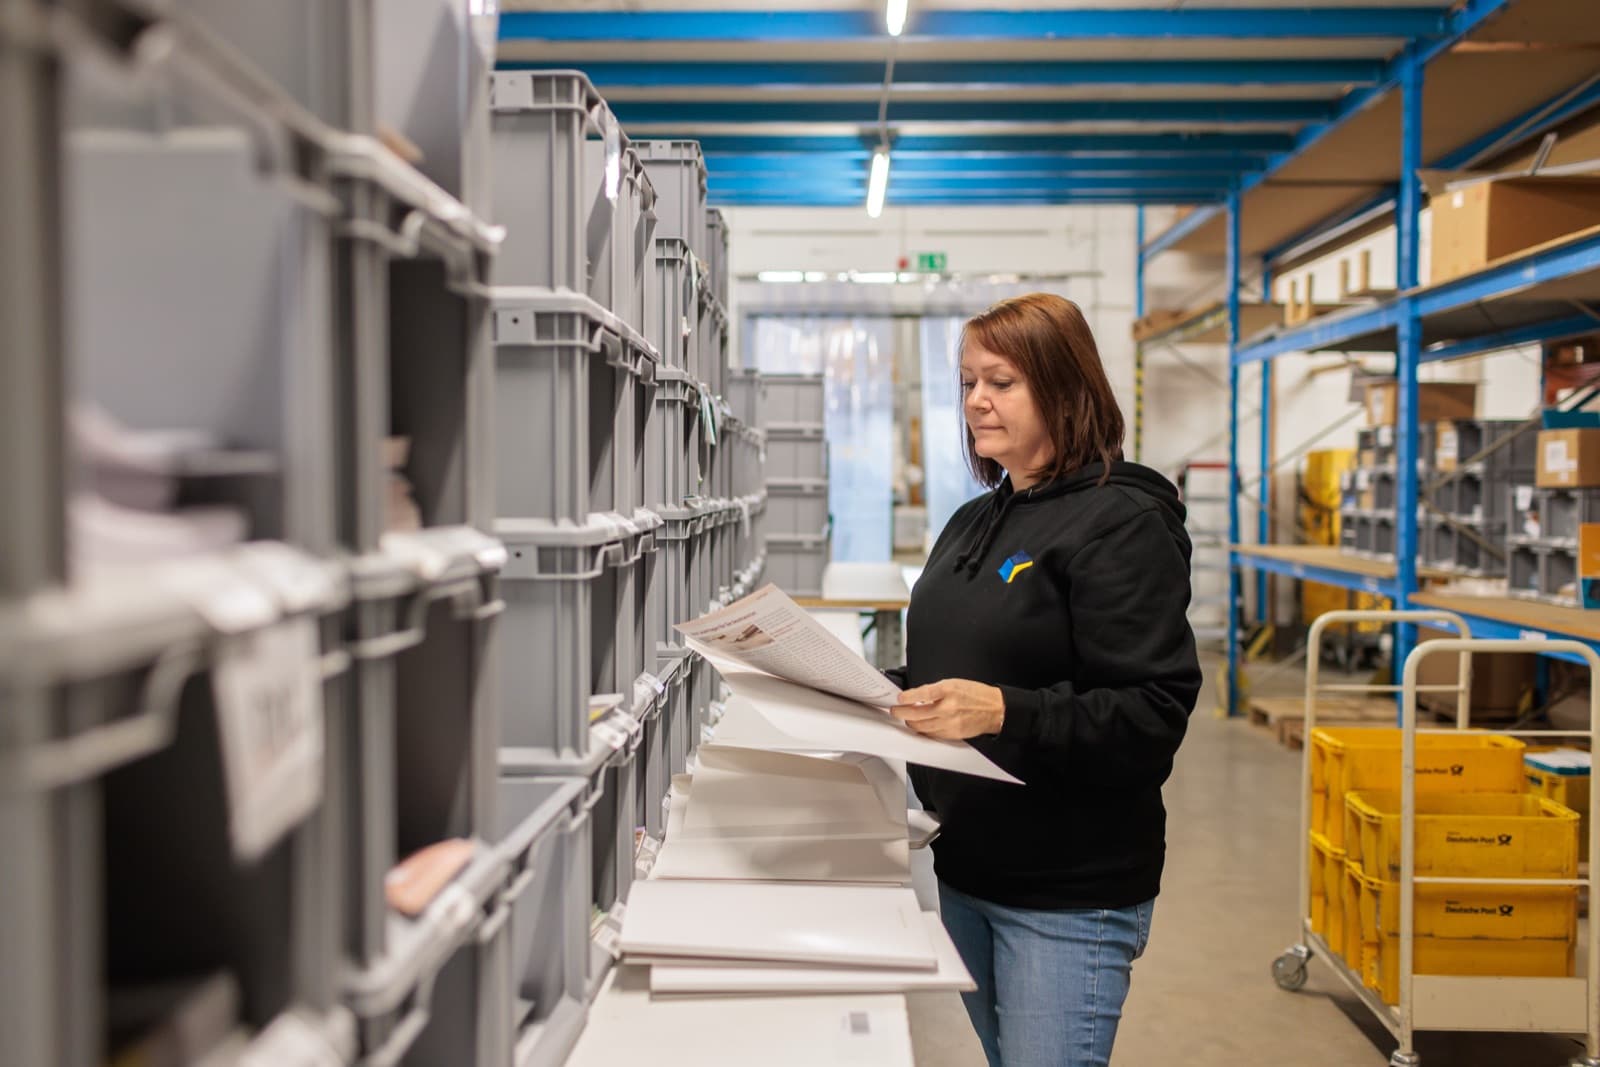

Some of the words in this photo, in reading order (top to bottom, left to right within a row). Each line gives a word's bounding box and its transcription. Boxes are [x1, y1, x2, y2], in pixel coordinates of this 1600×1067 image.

[1446, 836, 1479, 844] Deutsche
[1480, 836, 1496, 844] Post
[1445, 905, 1480, 914] Deutsche
[1481, 906, 1497, 914] Post
